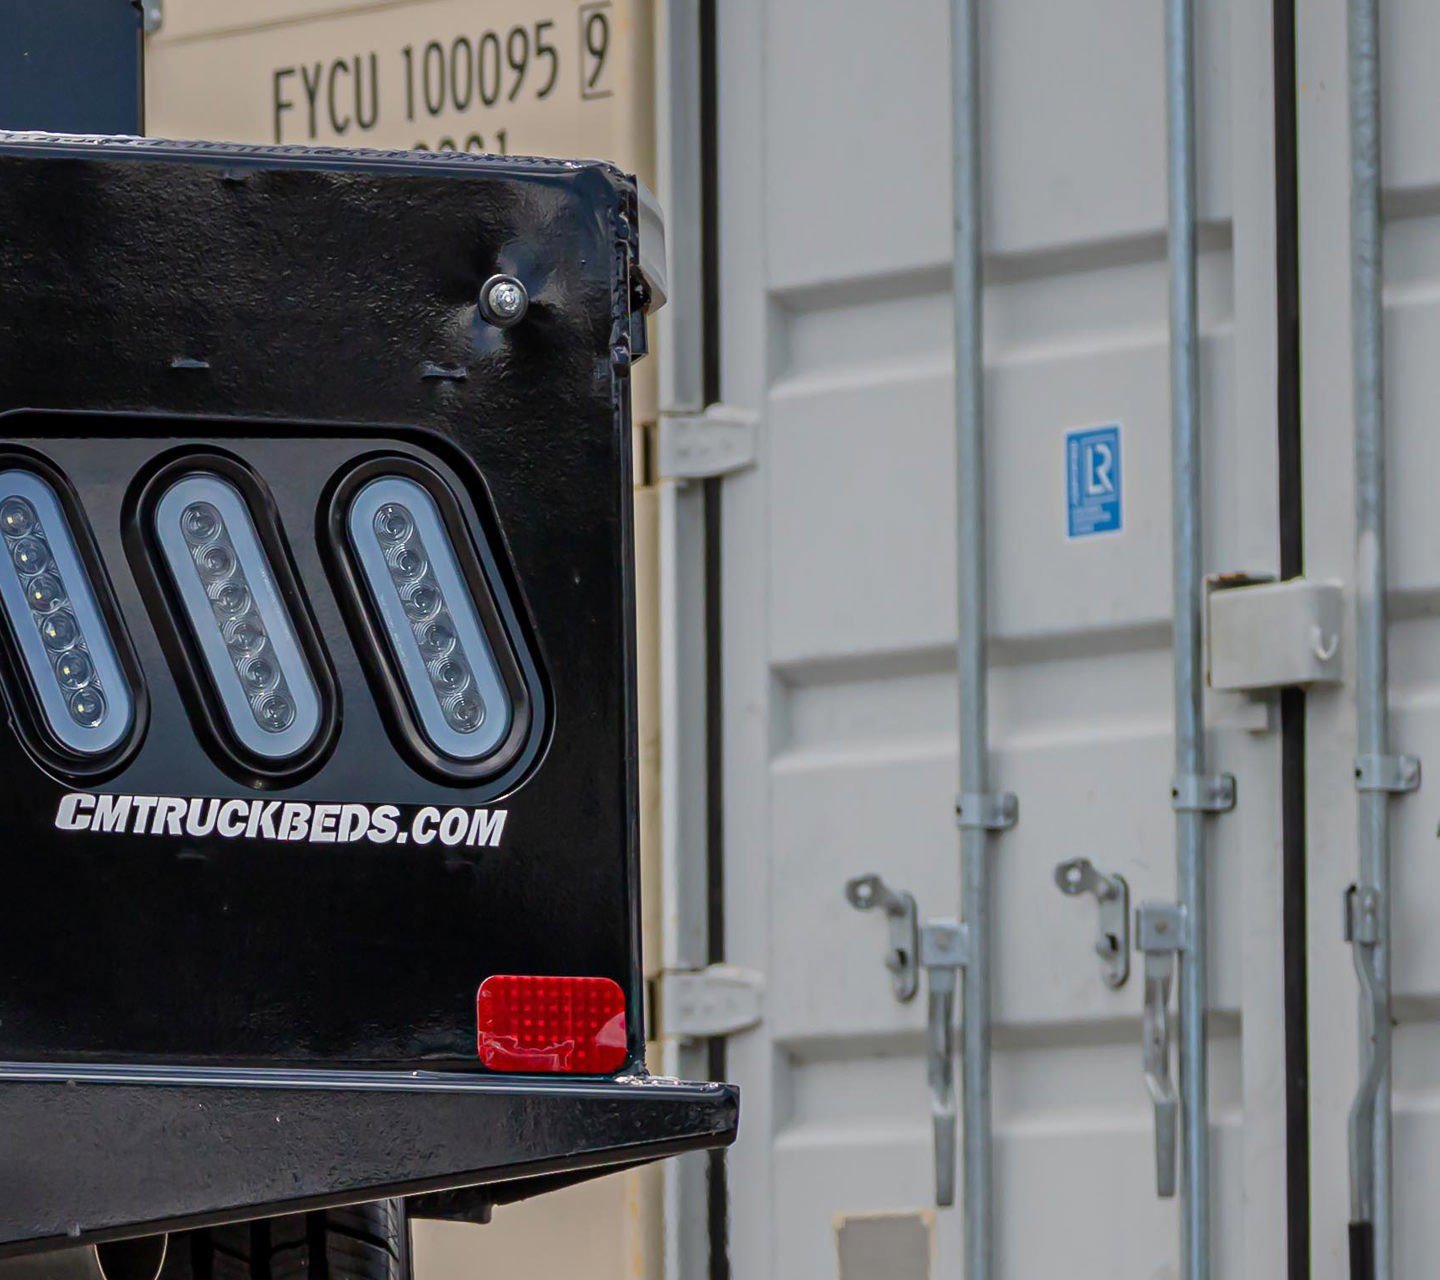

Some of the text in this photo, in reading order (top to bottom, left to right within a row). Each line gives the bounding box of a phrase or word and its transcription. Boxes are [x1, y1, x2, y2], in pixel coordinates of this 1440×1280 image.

[273, 11, 610, 145] FYCU 100095 9
[54, 792, 509, 848] CMTRUCKBEDS.COM
